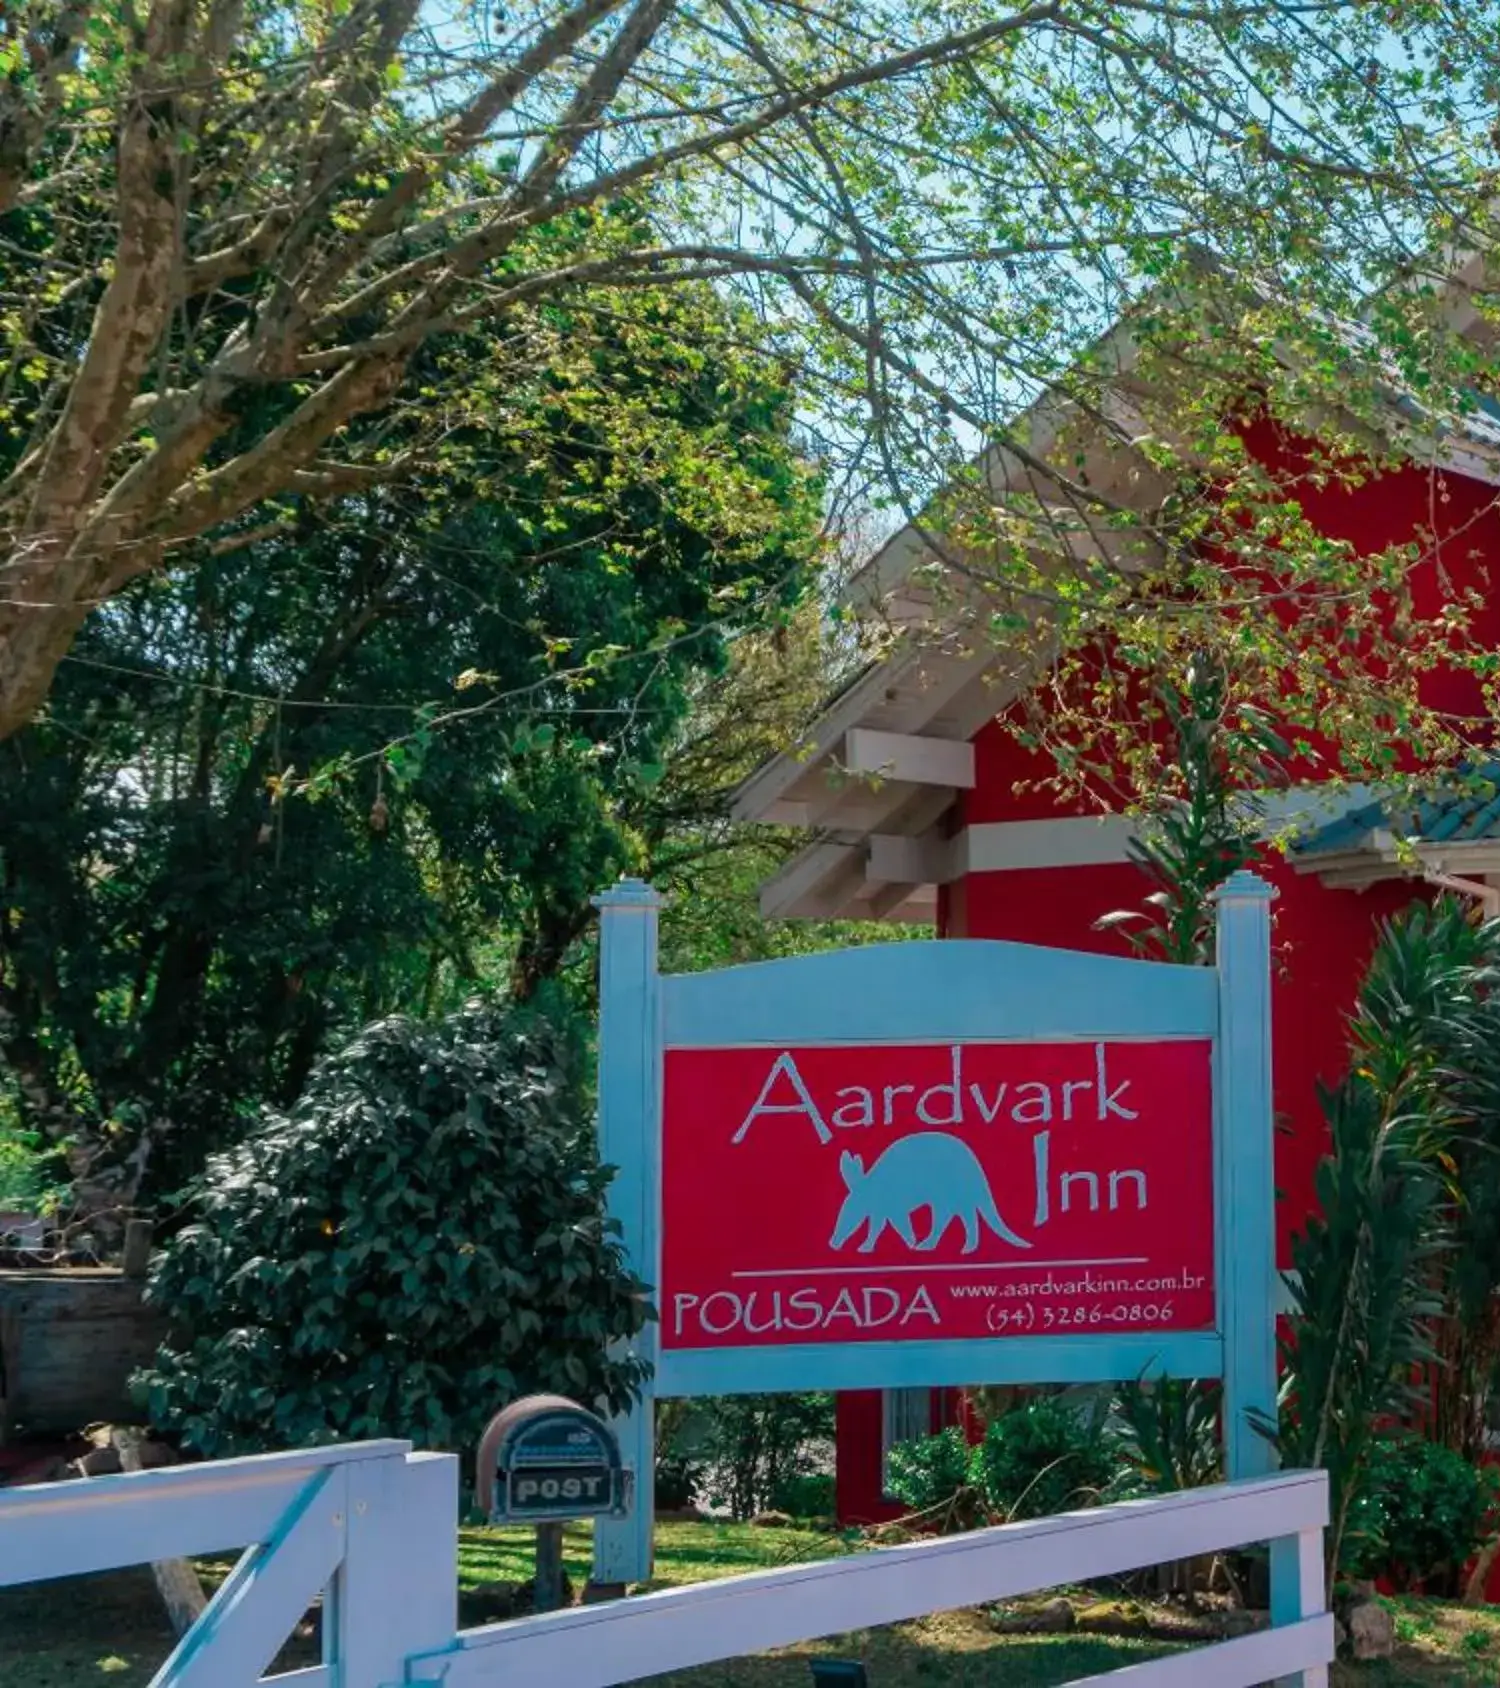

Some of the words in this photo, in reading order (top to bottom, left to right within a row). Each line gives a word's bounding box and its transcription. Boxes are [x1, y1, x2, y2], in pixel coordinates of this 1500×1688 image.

[732, 1043, 1138, 1144] Aardvark
[1034, 1130, 1148, 1227] Inn
[950, 1267, 1206, 1299] www.aardvarkinn.com.br
[673, 1285, 942, 1335] POUSADA
[986, 1302, 1035, 1331] (54)
[1043, 1301, 1174, 1328] 3286-0806
[517, 1477, 602, 1502] POST
